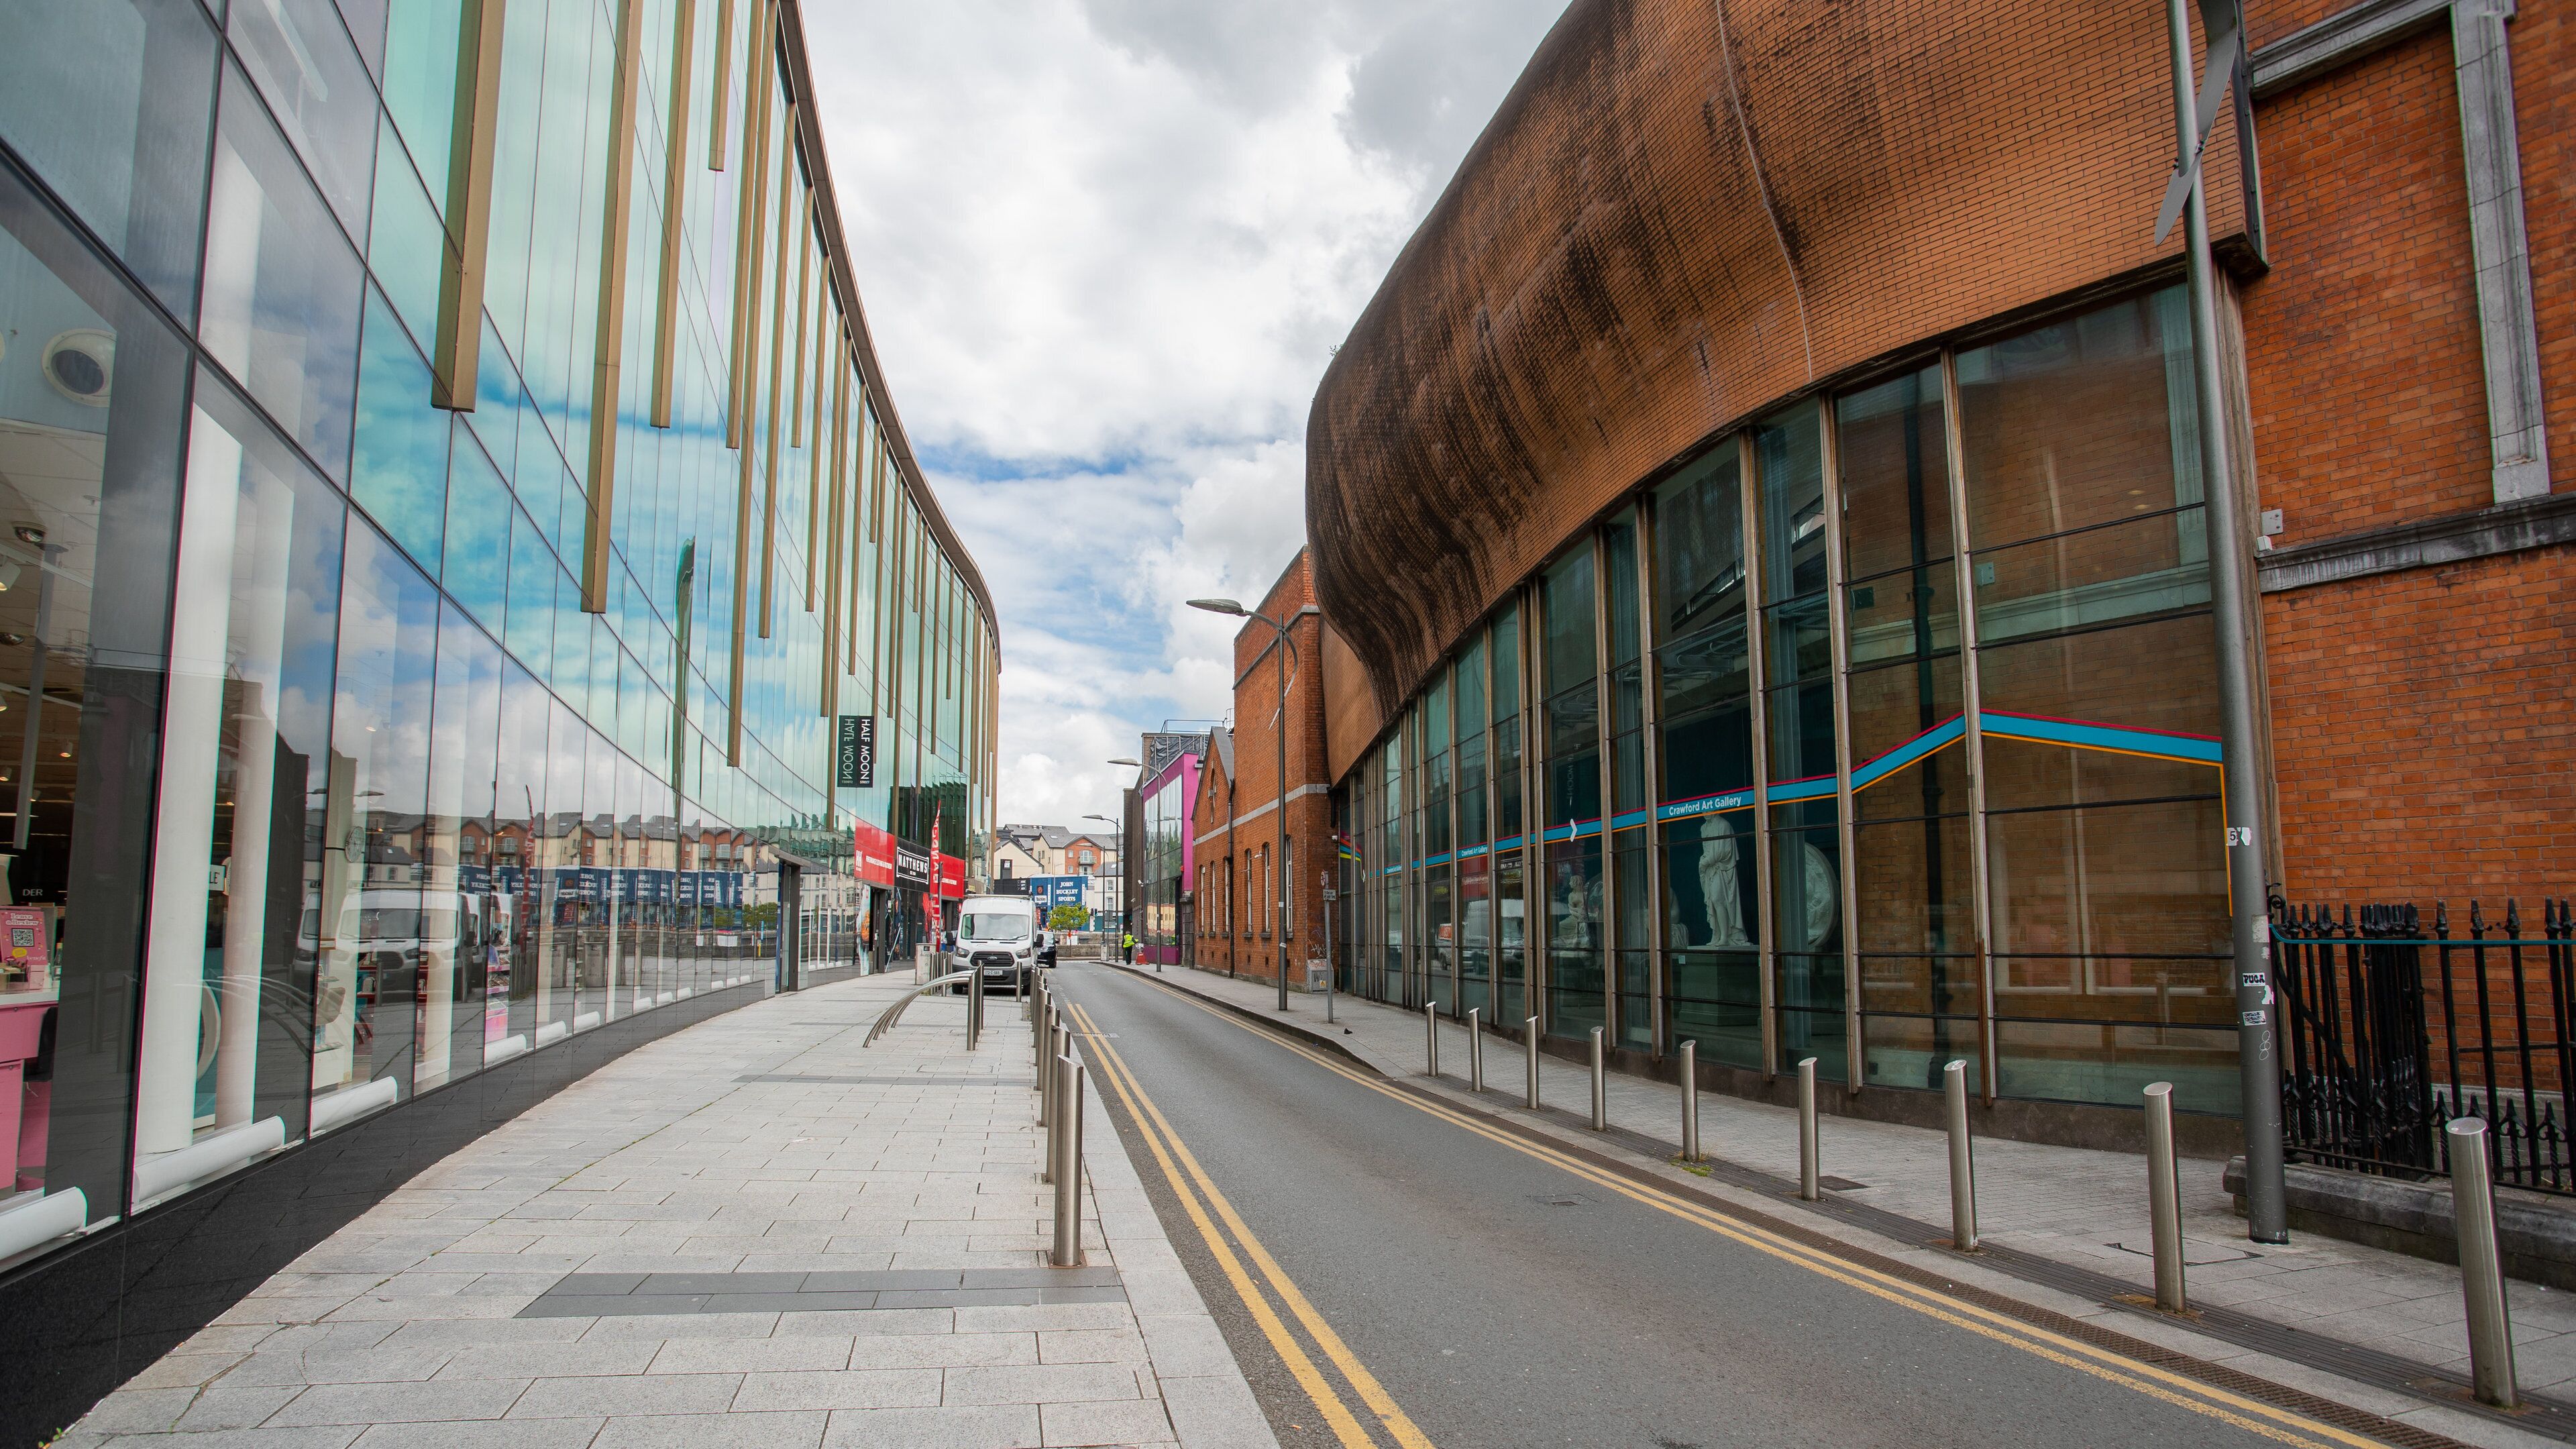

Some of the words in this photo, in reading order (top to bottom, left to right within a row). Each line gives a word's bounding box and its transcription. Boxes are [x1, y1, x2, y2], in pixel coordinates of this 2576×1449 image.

[861, 719, 871, 743] HALF
[860, 745, 870, 780] MOON
[1669, 802, 1700, 816] Crawford
[1702, 800, 1713, 810] Art
[1715, 796, 1741, 808] Gallery
[898, 854, 928, 873] MATTHEWS
